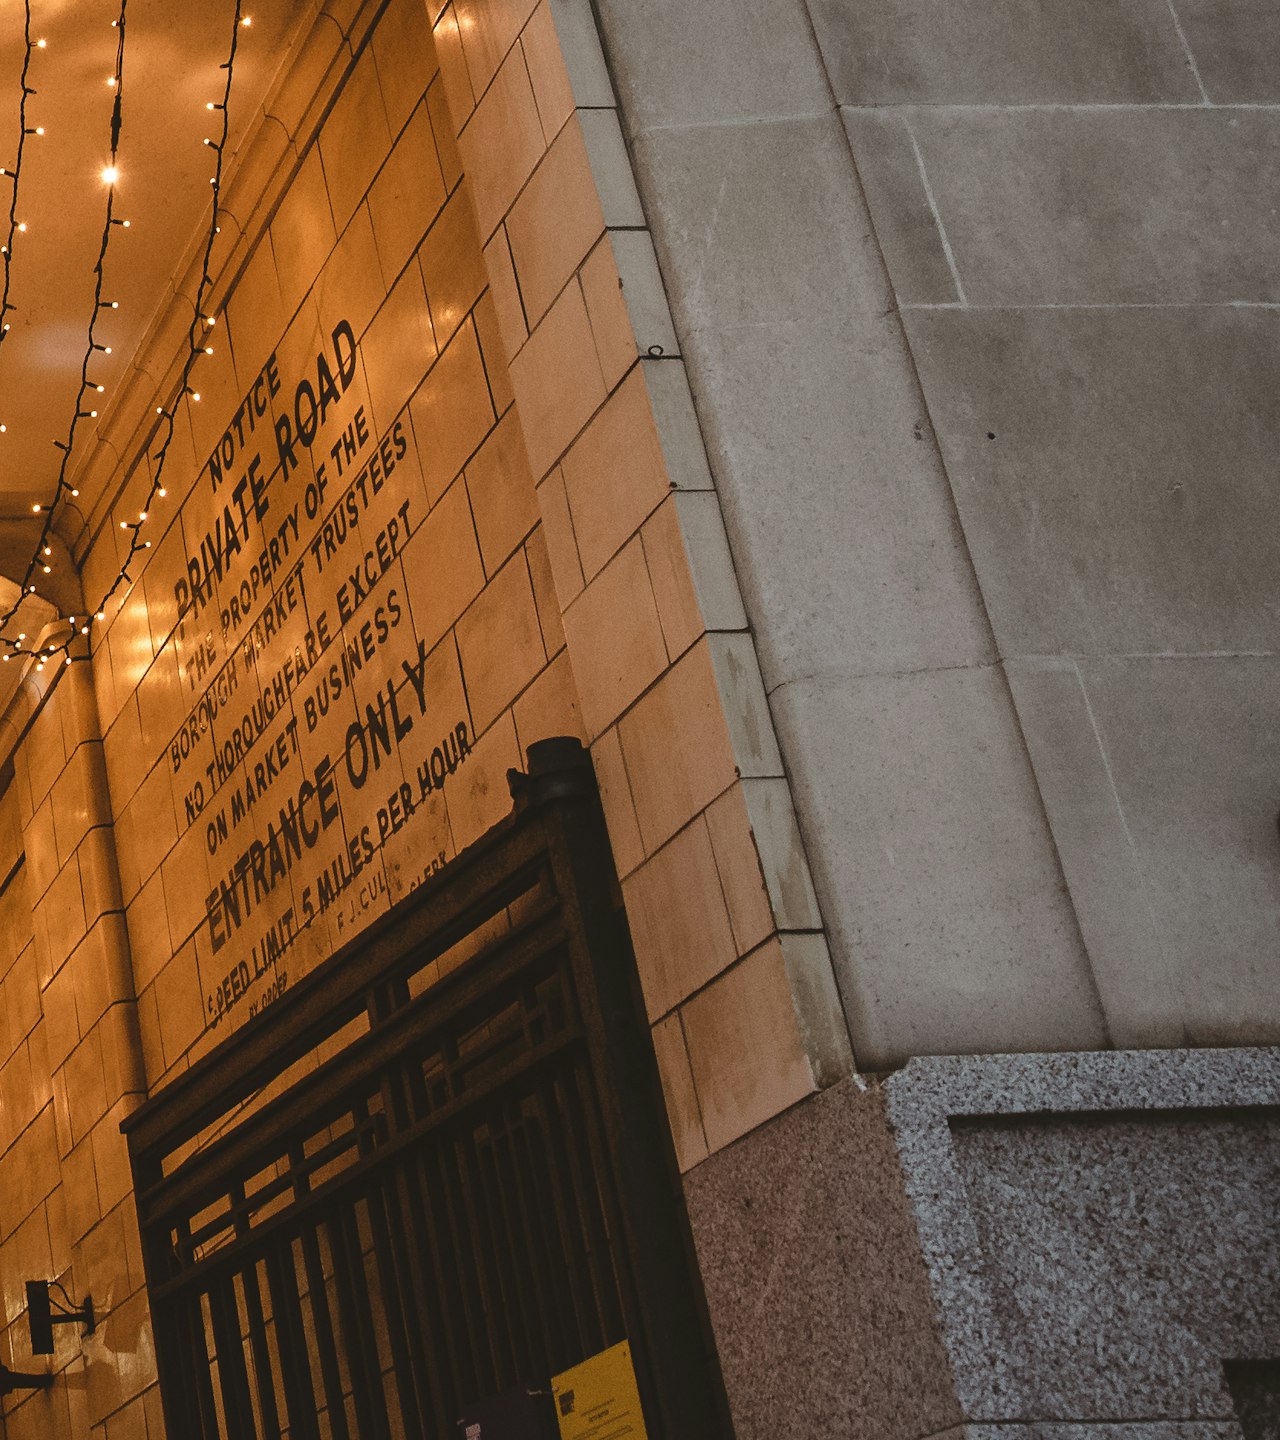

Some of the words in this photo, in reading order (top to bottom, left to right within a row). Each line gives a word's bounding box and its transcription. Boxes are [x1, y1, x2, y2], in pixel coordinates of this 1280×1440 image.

[174, 453, 269, 640] PRIVATE
[275, 319, 357, 483] ROAD
[186, 630, 217, 691] THE
[220, 503, 300, 646] PROPERTY
[305, 463, 328, 520] OF
[331, 405, 369, 477] THE
[208, 352, 281, 493] NOTICE
[171, 658, 238, 774] BOROUGH
[243, 562, 305, 674] MARKET
[311, 421, 407, 573] TRUSTEES
[184, 781, 205, 824] NO
[206, 611, 331, 795] THOROUGHFARE
[336, 497, 412, 626] EXCEPT
[207, 809, 228, 856] ON
[230, 715, 298, 829] MARKET
[304, 589, 401, 733] BUSINESS
[205, 754, 339, 956] ENTRANCE
[345, 639, 429, 790] ONLY
[251, 907, 295, 981] LIMIT
[301, 885, 315, 928] 5
[317, 825, 374, 914] MILES
[375, 782, 416, 849] PER
[417, 720, 473, 803] HOUR
